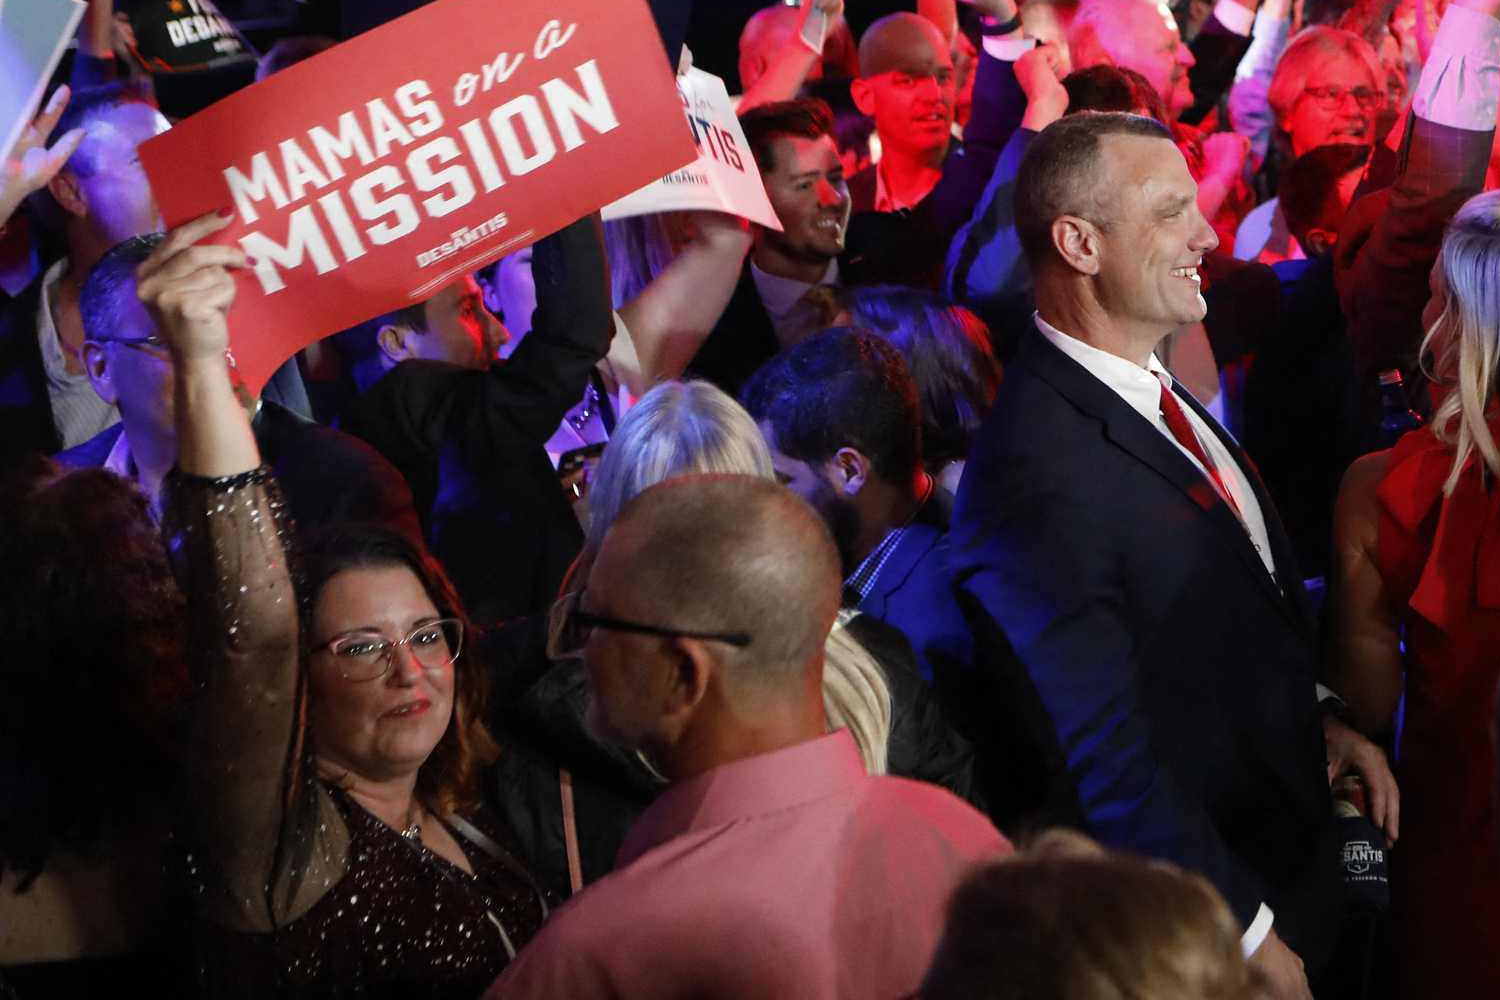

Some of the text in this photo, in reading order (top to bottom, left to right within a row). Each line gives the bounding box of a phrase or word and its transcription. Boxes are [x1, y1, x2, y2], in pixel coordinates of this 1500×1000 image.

[222, 19, 577, 225] MAMAS on a
[238, 58, 620, 296] MISSION
[415, 211, 508, 269] DESANTIS
[1342, 850, 1384, 863] SANTIS
